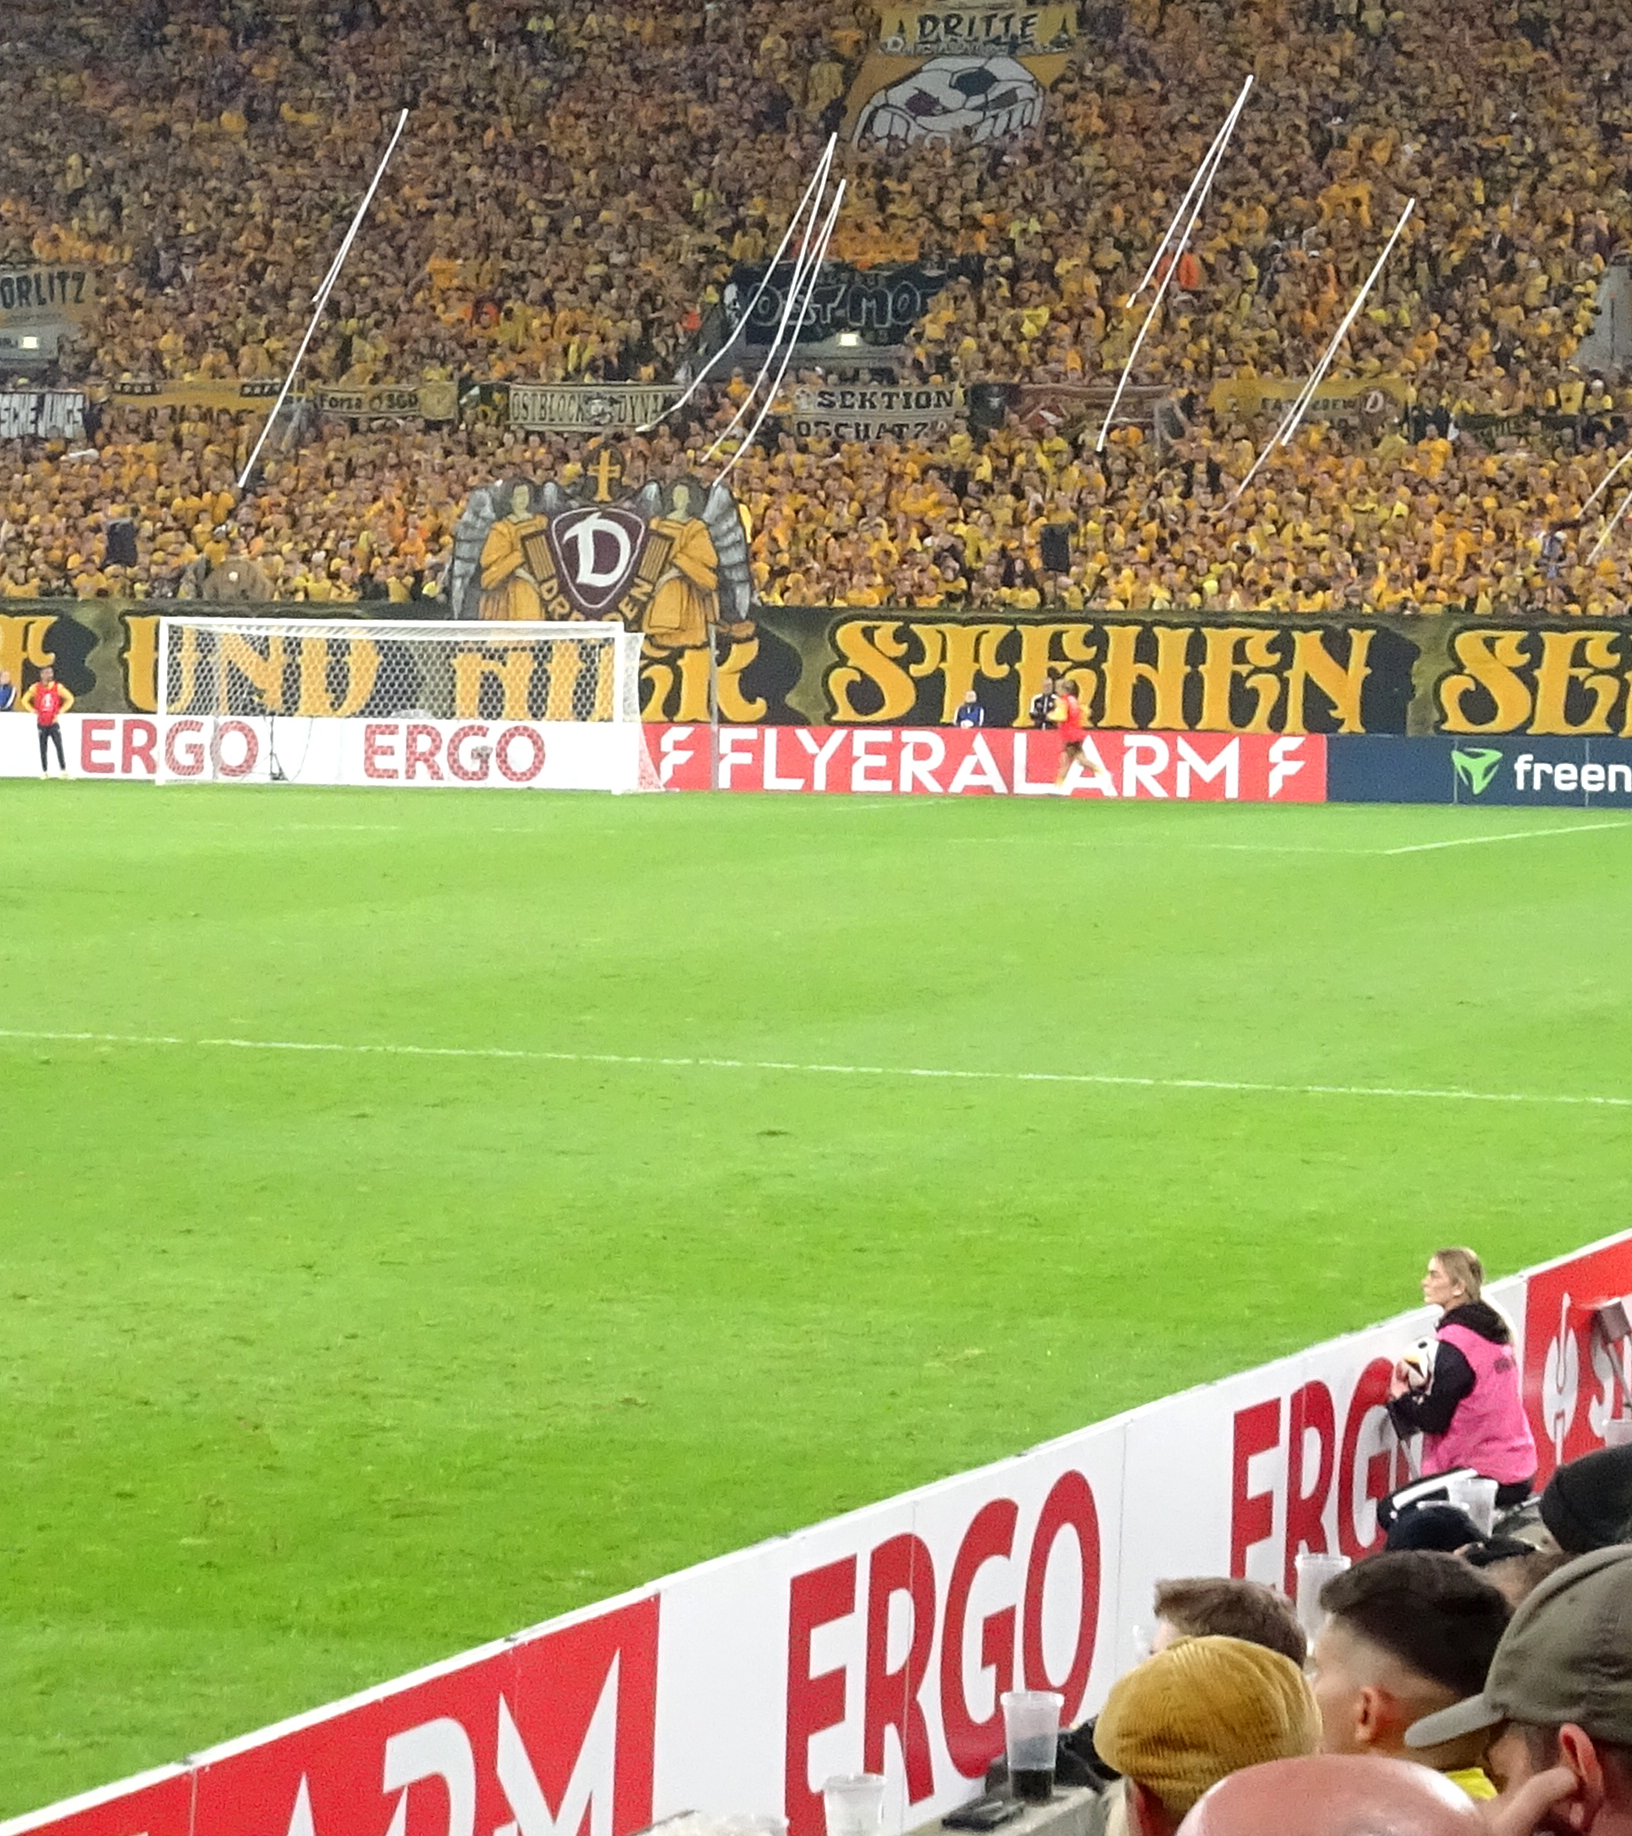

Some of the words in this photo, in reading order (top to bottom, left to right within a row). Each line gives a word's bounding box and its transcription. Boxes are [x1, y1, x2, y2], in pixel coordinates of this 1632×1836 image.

[918, 13, 1037, 41] DRITTE
[817, 387, 954, 411] SEKTION
[563, 511, 631, 587] D
[831, 620, 1374, 734] STEHEN
[80, 718, 261, 778] ERGO
[363, 723, 546, 783] ERGO
[719, 726, 1240, 800] FLYERALARM
[785, 1469, 1103, 1836] ERGO
